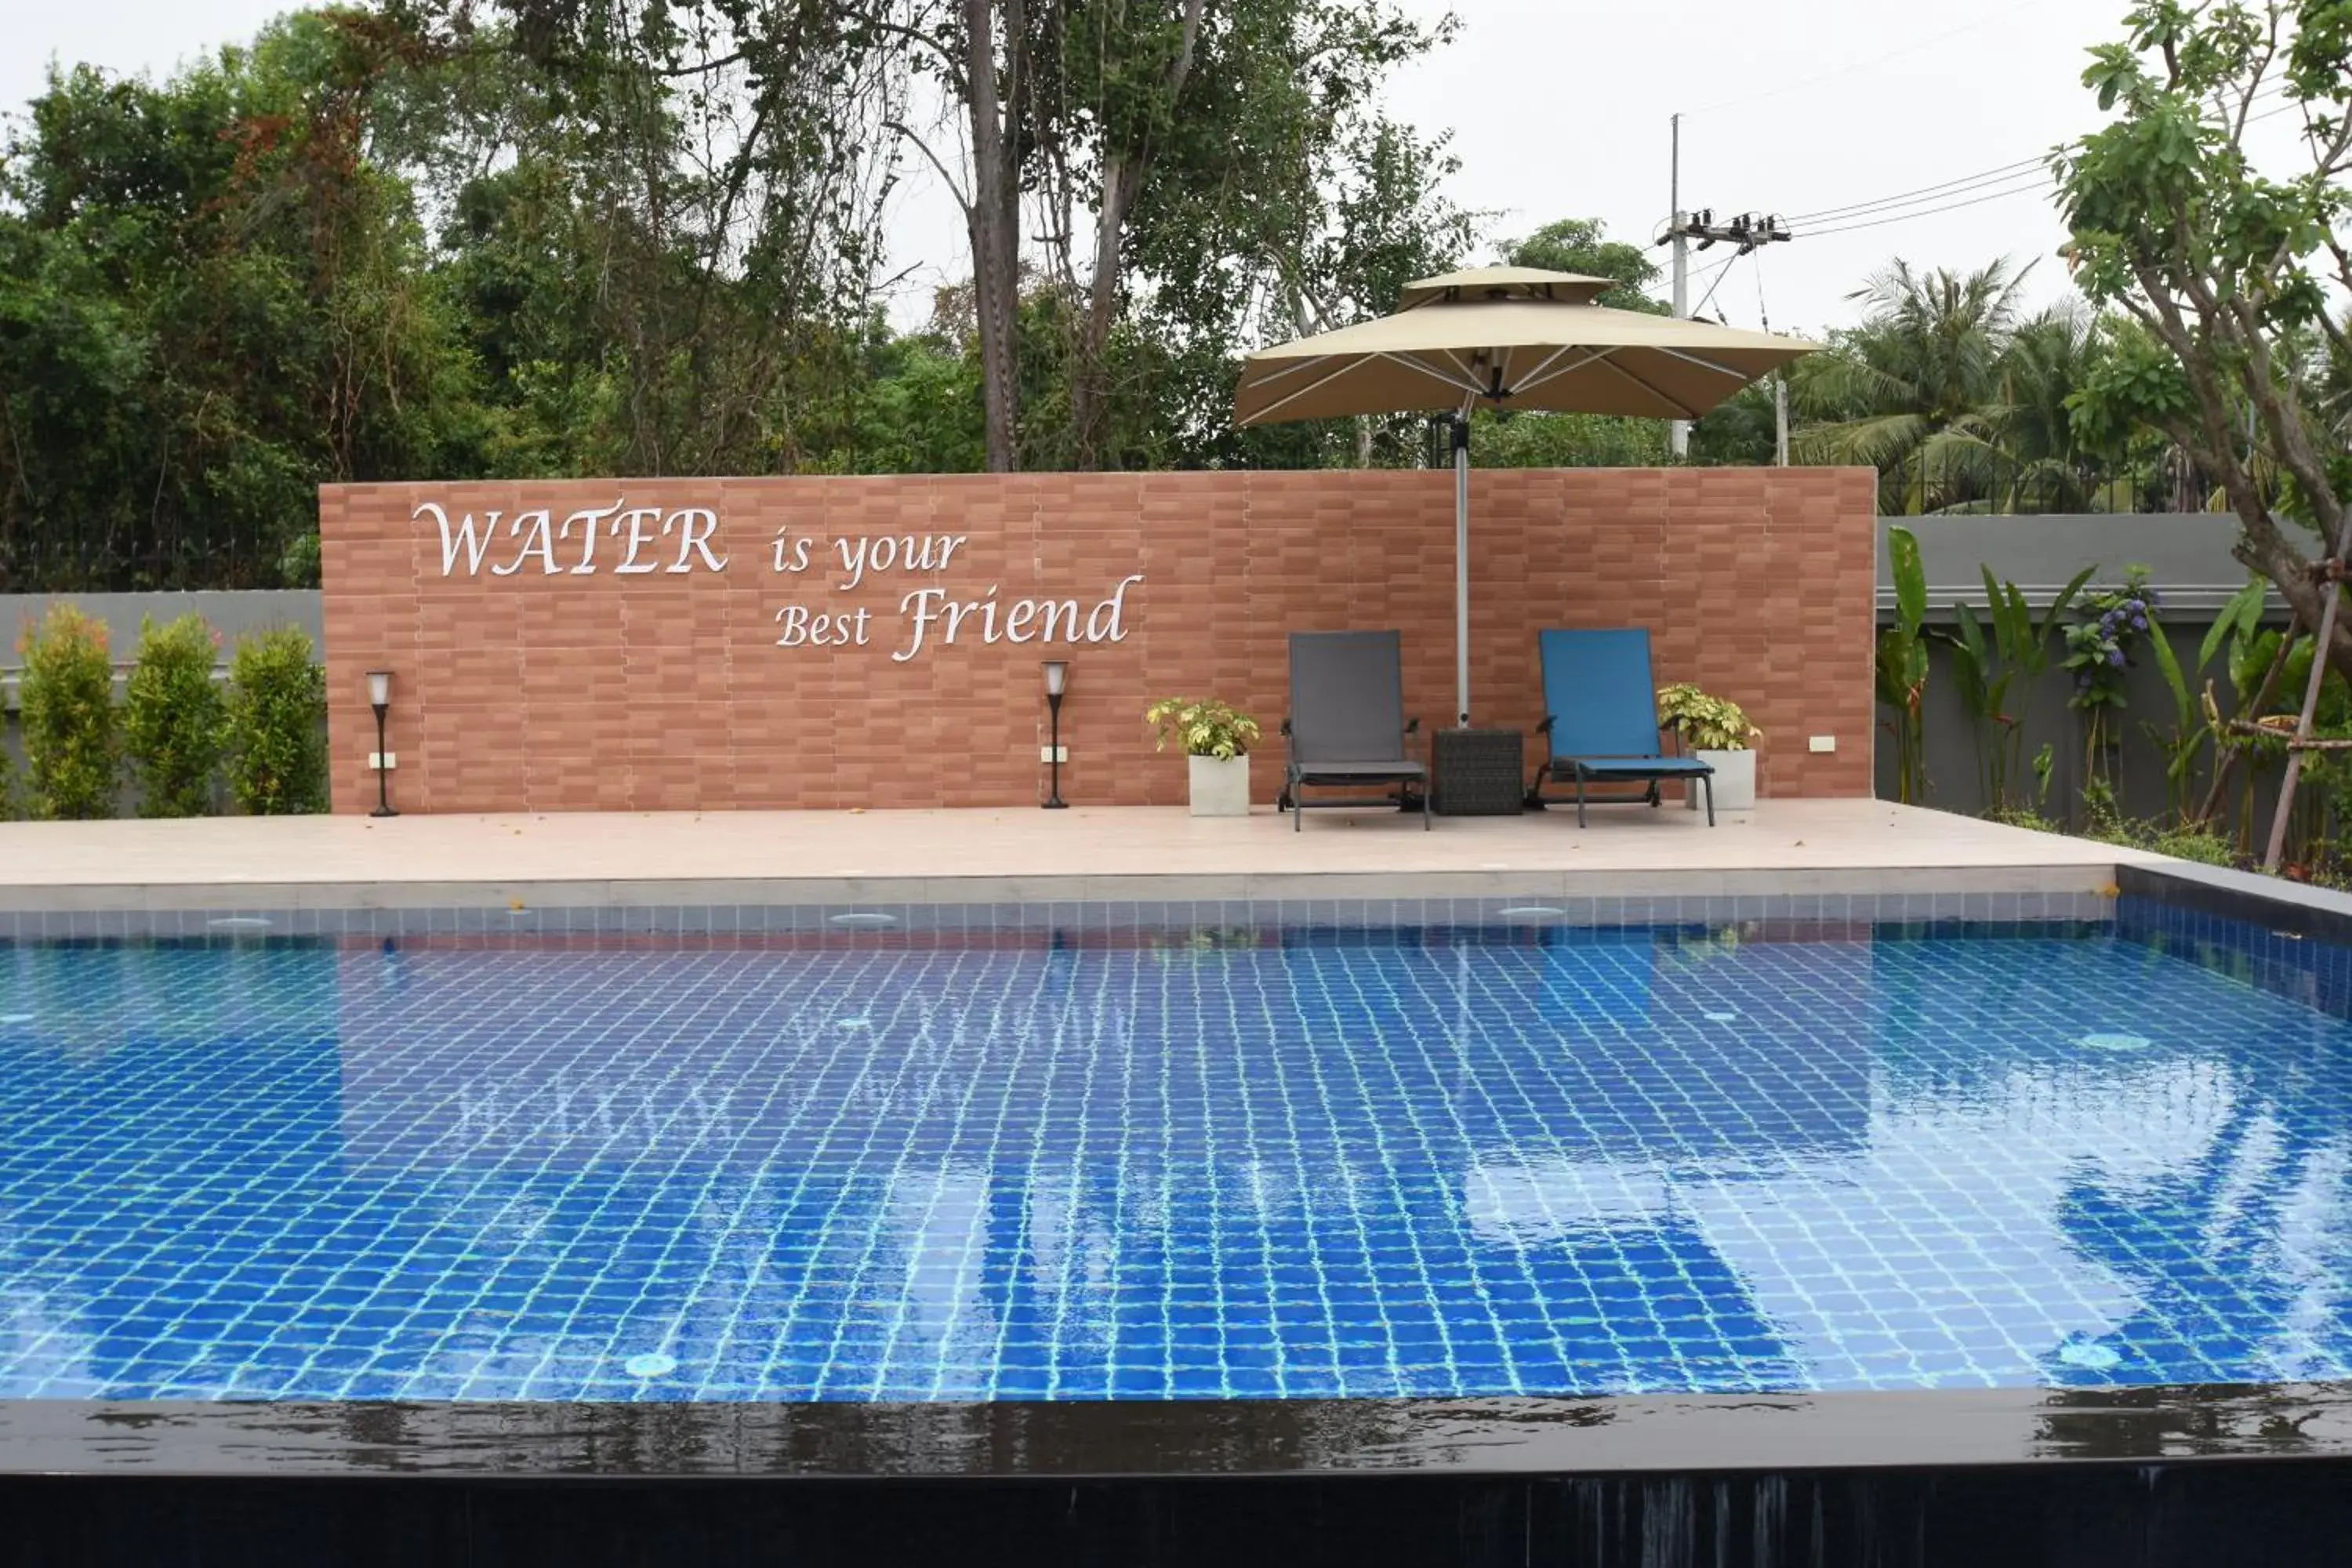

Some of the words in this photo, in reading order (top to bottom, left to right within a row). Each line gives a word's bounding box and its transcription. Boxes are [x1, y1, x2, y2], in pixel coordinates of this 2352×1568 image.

[412, 497, 729, 577] WATER
[771, 526, 813, 572] is
[834, 532, 967, 591] your
[775, 604, 872, 647] Best
[891, 575, 1145, 663] Friend
